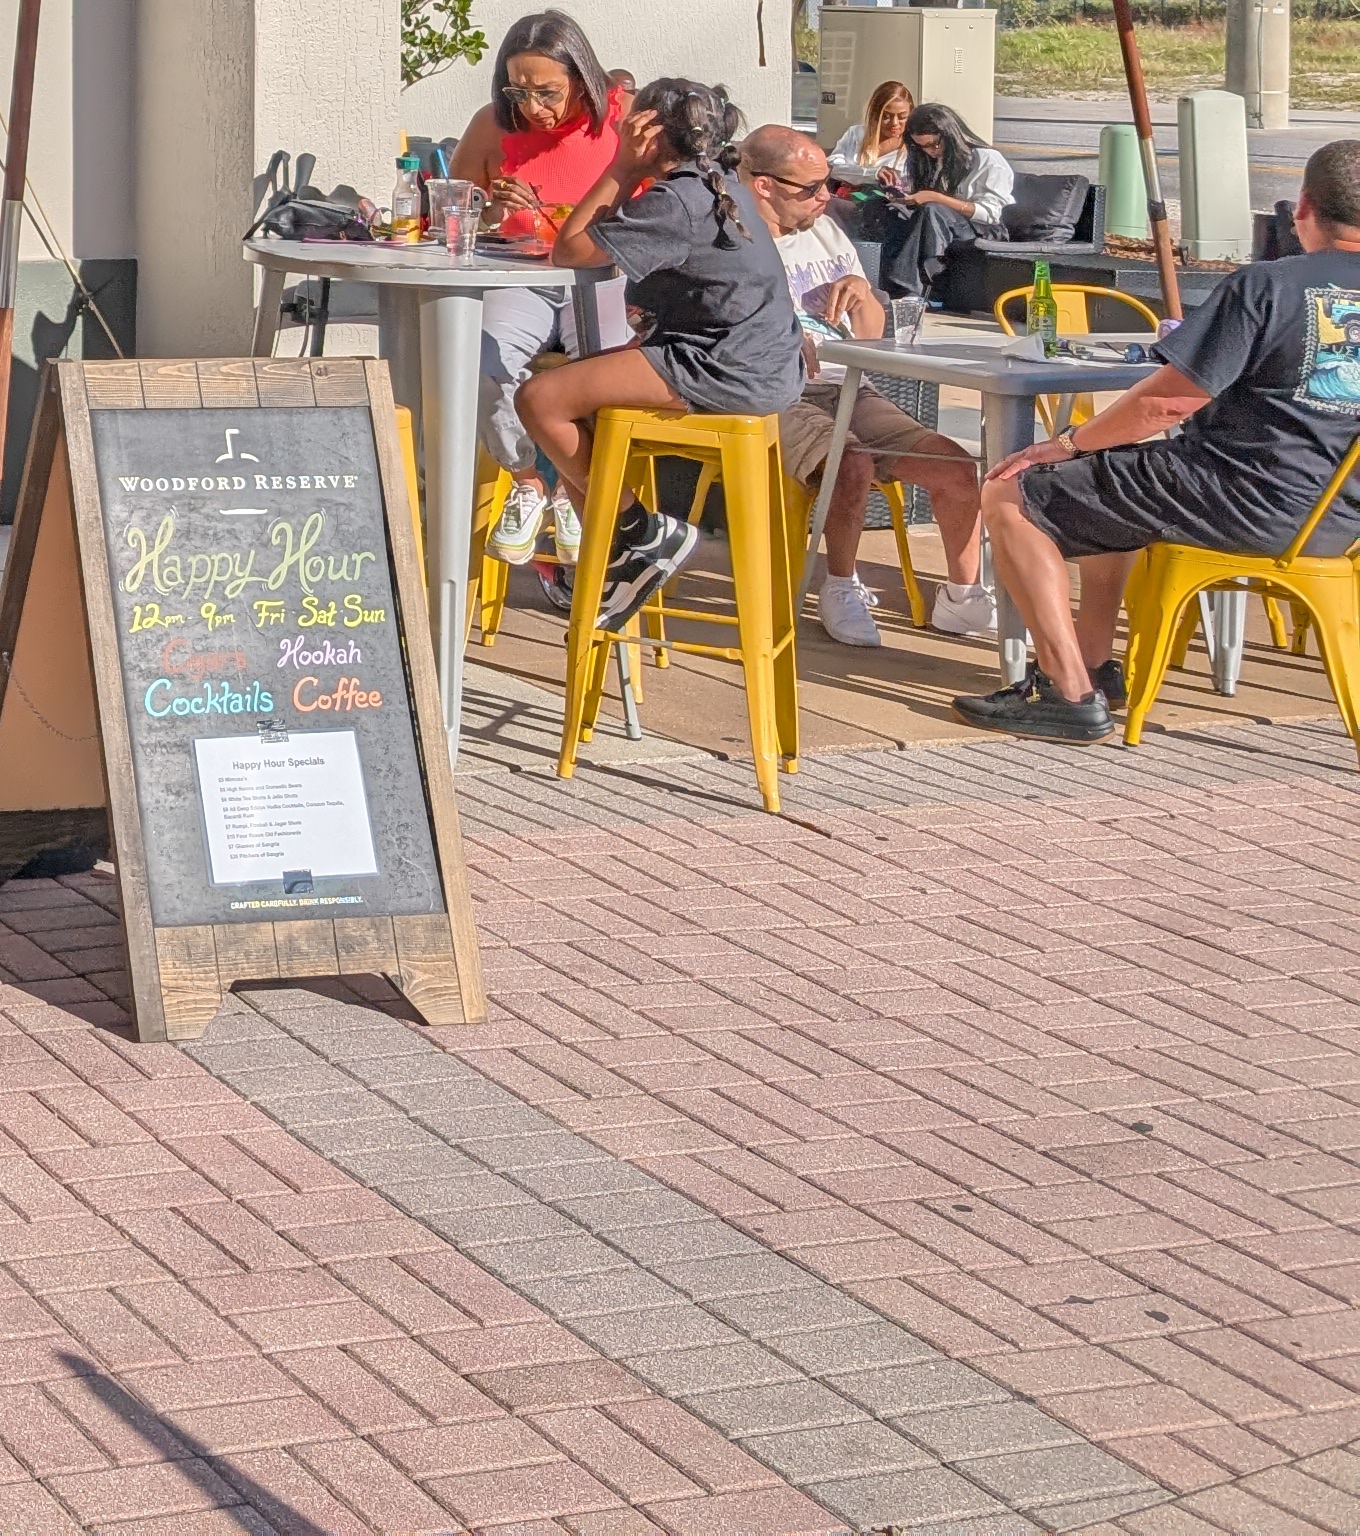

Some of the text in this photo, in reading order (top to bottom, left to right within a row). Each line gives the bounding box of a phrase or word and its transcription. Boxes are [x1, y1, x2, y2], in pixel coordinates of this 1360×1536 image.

[119, 476, 246, 492] WOODFORD
[125, 513, 376, 599] Happy Hour
[129, 603, 185, 633] 12pm
[200, 602, 236, 631] 9pm
[253, 600, 285, 628] Fri
[297, 596, 337, 627] Sat
[343, 594, 386, 628] Sun
[277, 635, 362, 669] Hookah
[144, 676, 383, 717] Cocktails Coffee
[232, 756, 325, 771] Happy Hour Specials
[231, 900, 261, 910] CRAFTED
